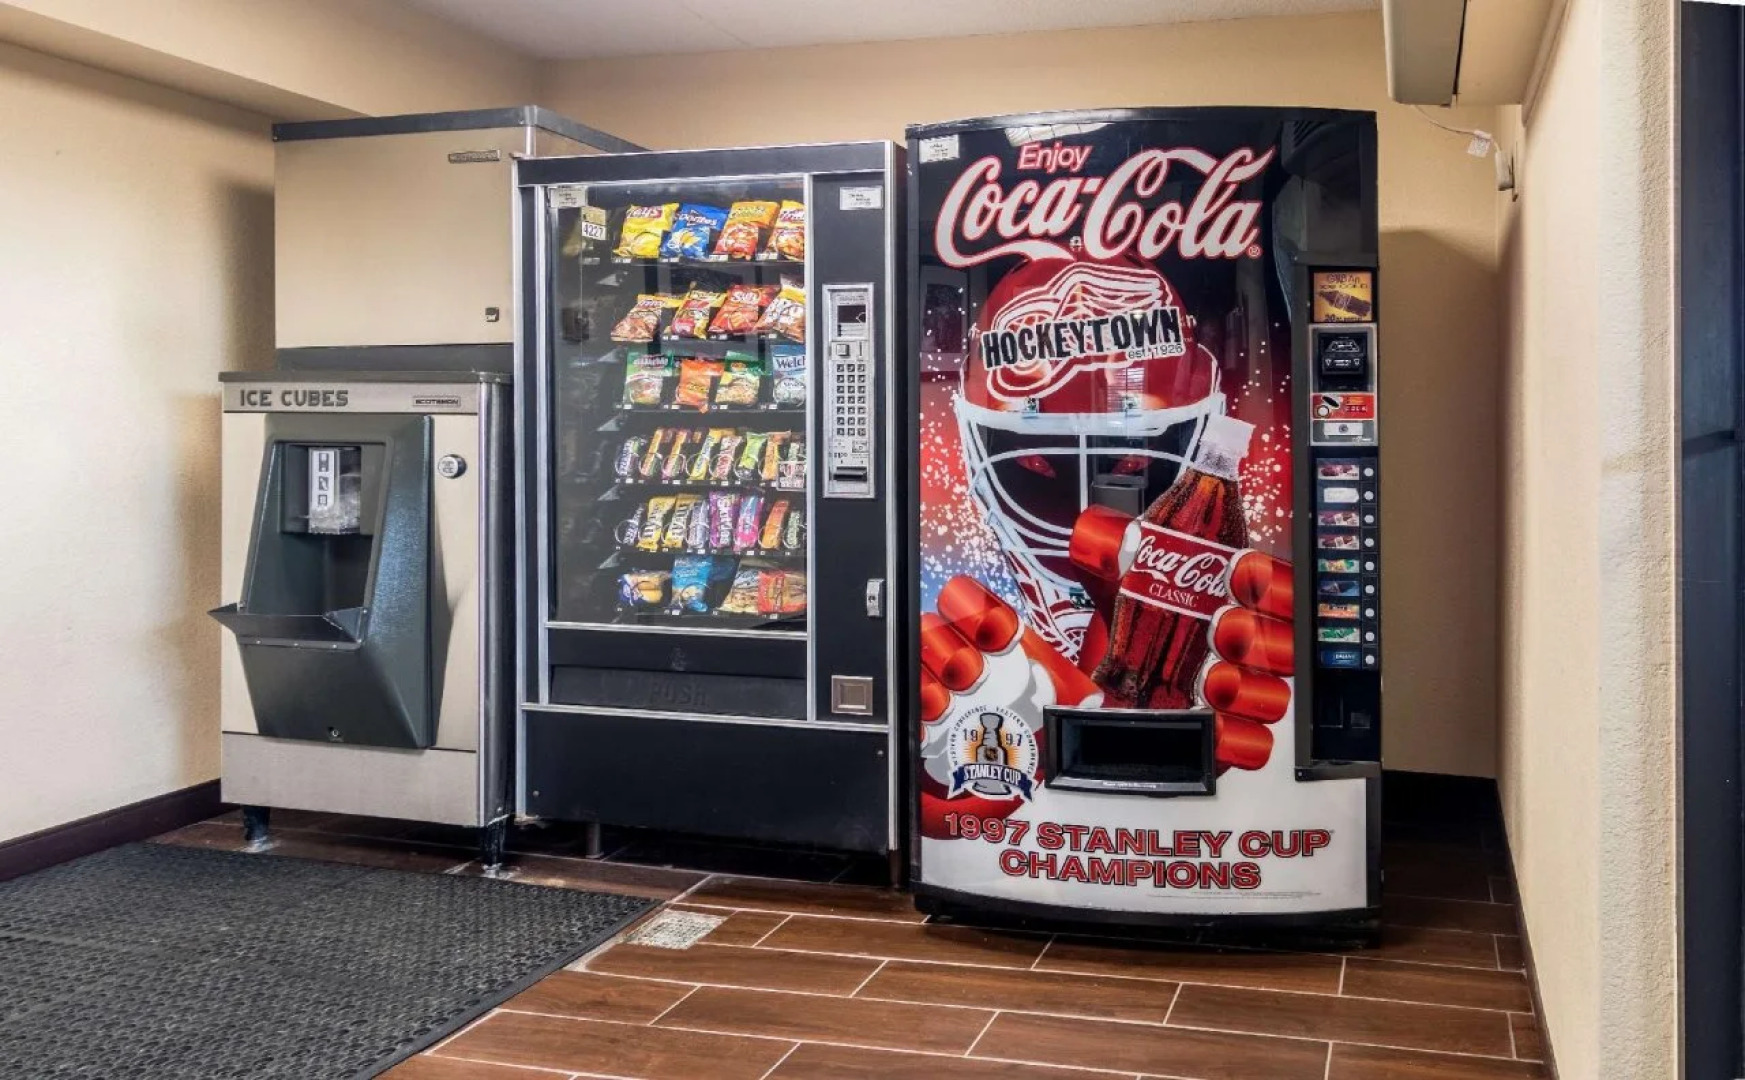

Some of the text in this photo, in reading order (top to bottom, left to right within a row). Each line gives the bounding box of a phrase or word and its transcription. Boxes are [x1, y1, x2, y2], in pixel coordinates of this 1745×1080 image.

[1017, 142, 1092, 173] Enjoy
[935, 146, 1276, 268] Coca-Cola
[583, 223, 604, 238] 4227
[983, 308, 1182, 368] HOCKEYTOWN
[240, 389, 349, 407] ICE CUBES
[1148, 583, 1197, 608] CLASSIC
[963, 728, 1022, 747] 19 97
[964, 764, 1022, 785] STANLEY CUP
[944, 812, 1332, 859] 1997 STANLEY CUP
[999, 848, 1263, 890] CHAMPIONS
